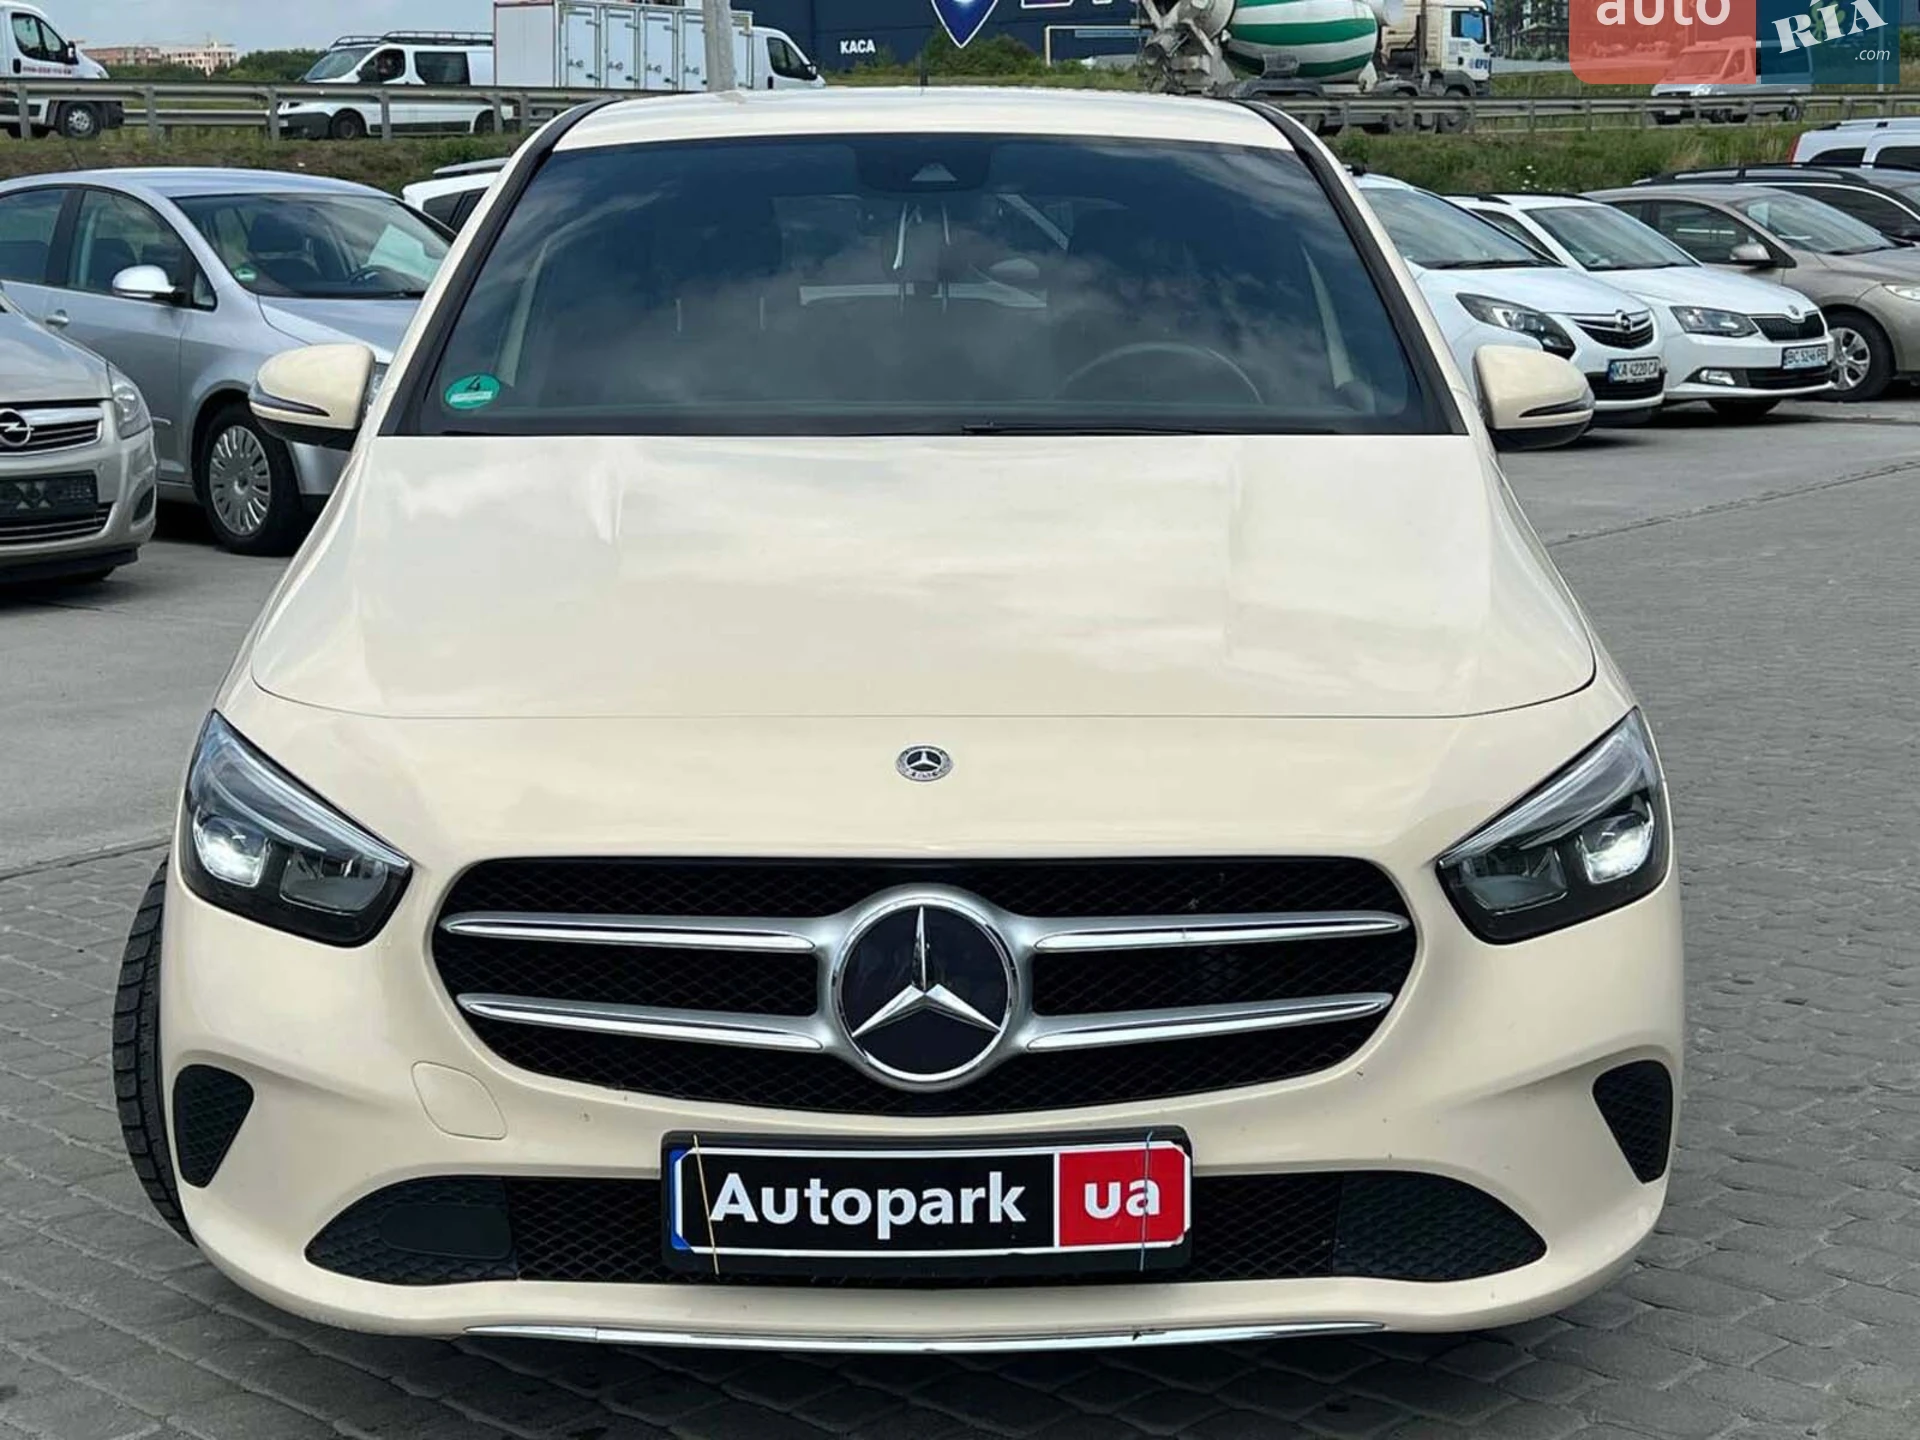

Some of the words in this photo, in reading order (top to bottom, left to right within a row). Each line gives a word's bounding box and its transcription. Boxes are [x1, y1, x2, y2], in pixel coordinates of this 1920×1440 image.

[840, 38, 876, 55] КАСА
[1612, 363, 1627, 378] KA
[465, 375, 480, 392] 4
[710, 1171, 1026, 1240] Autopark
[1084, 1176, 1160, 1221] ua
